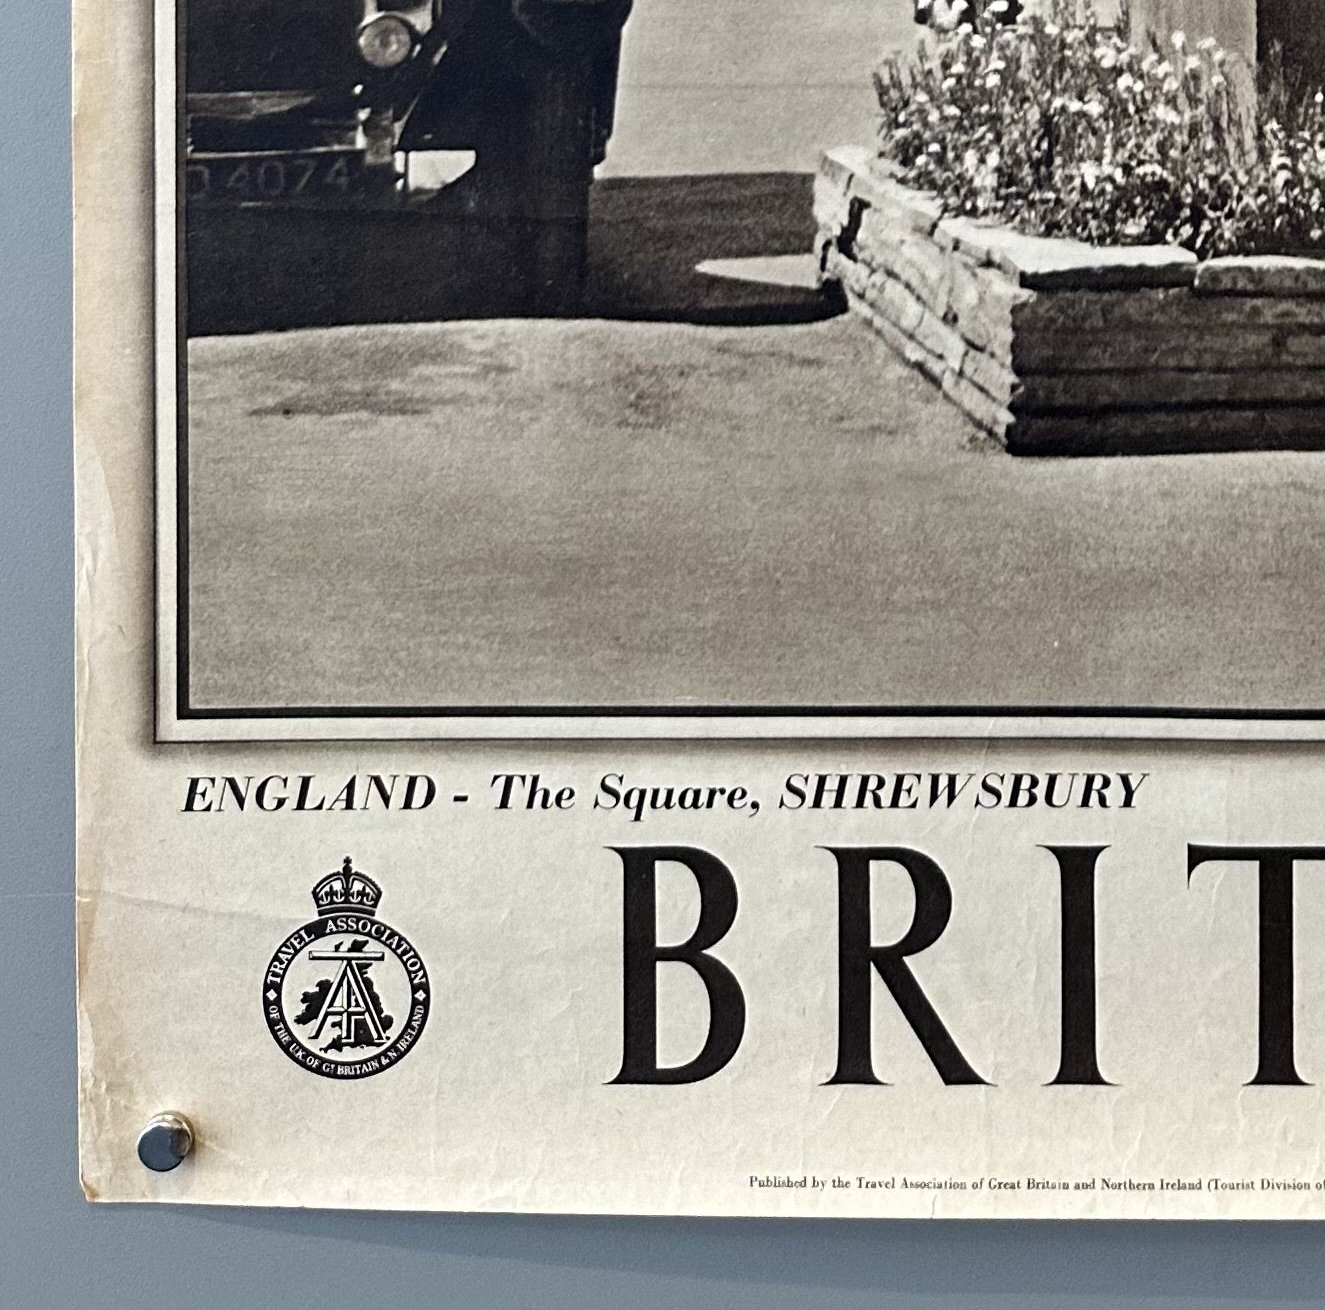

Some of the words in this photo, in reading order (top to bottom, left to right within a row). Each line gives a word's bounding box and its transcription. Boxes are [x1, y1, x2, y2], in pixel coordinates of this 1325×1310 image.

[180, 774, 437, 813] ENGLAND
[490, 773, 576, 811] The
[593, 772, 761, 823] Square,
[778, 771, 1151, 811] SHREWSBURY
[266, 928, 315, 984] TRAVEL
[325, 917, 427, 985] ASSOCIATION
[269, 1005, 280, 1020] OF
[274, 1022, 291, 1046] THE
[397, 1005, 425, 1051] IRELAND
[306, 1054, 321, 1068] OF
[337, 1060, 380, 1075] BRITAIN
[749, 1176, 807, 1189] Published
[811, 1176, 828, 1192] by
[831, 1176, 851, 1189] the
[855, 1176, 896, 1190] Travel
[900, 1177, 968, 1191] Association
[971, 1177, 985, 1191] of
[988, 1177, 1021, 1191] Great
[1026, 1177, 1070, 1191] Britain
[1073, 1177, 1096, 1191] and
[1100, 1177, 1156, 1192] Northern
[1159, 1177, 1203, 1191] Ireland
[1207, 1177, 1256, 1192] (Tourist
[1260, 1177, 1312, 1191] Division
